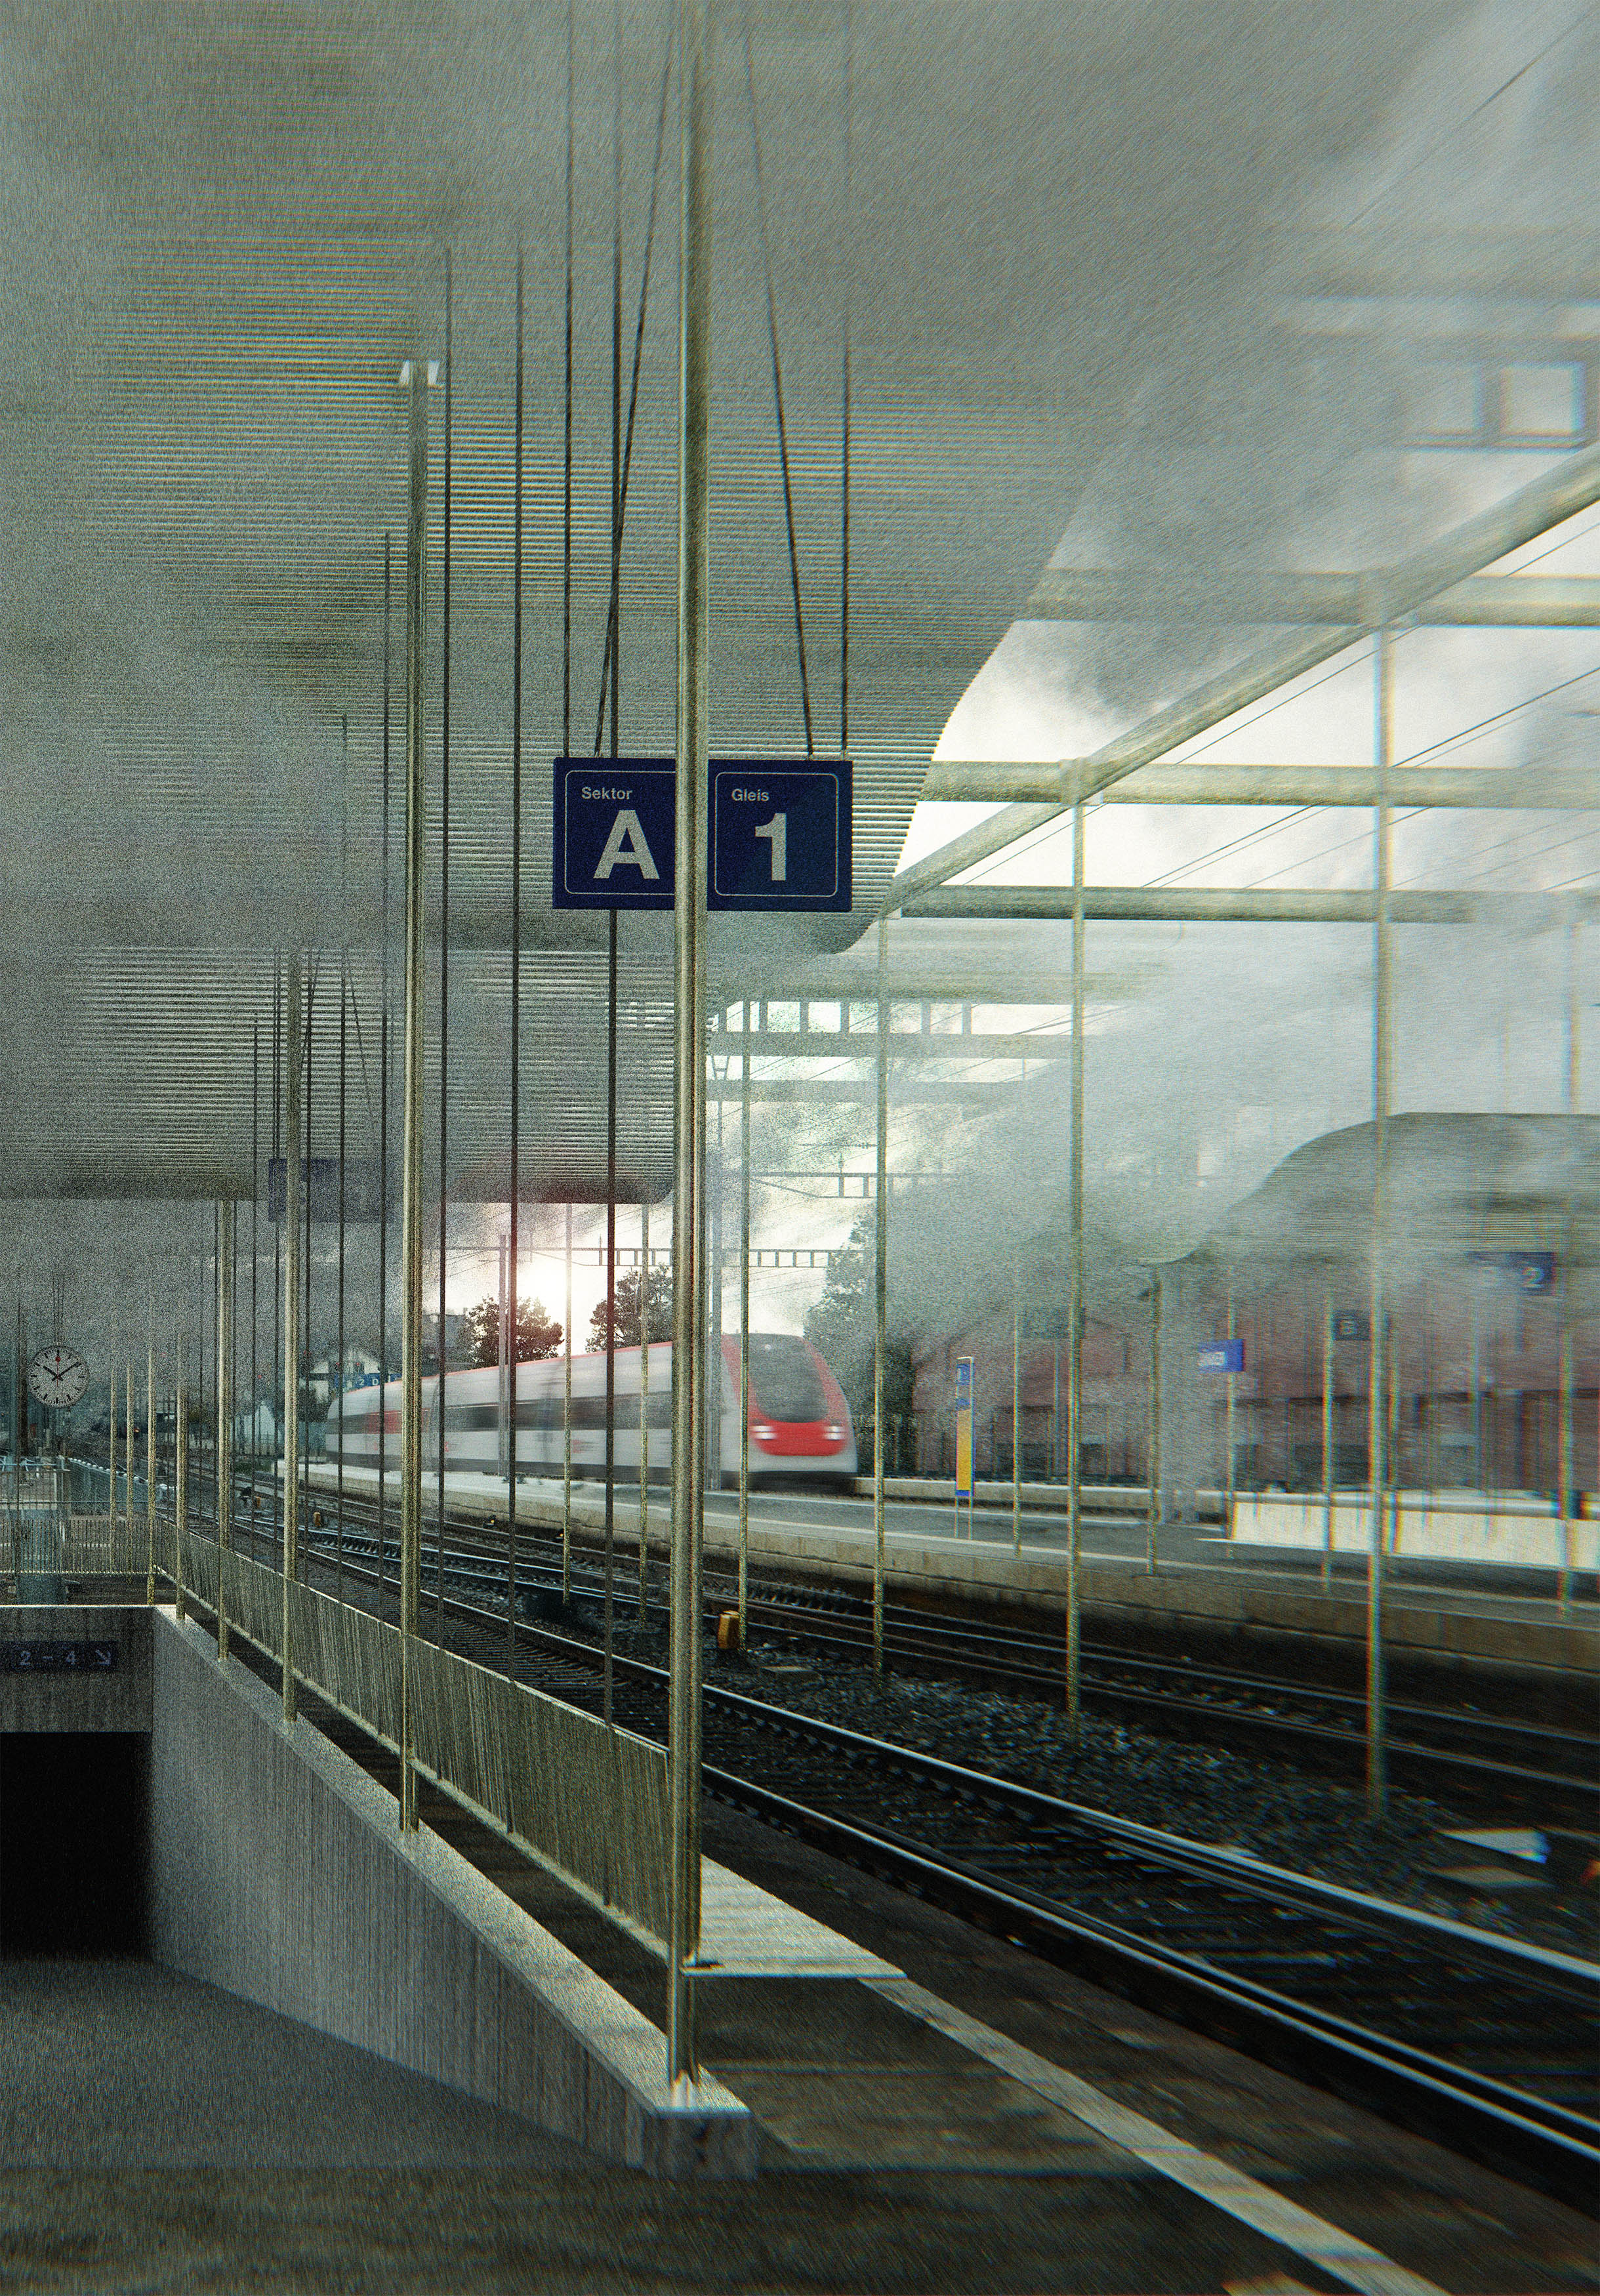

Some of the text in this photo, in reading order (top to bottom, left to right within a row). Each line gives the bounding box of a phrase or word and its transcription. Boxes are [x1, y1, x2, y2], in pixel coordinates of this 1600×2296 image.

[581, 787, 633, 800] Sektor
[731, 789, 770, 802] Gleis
[593, 810, 660, 880] A
[755, 813, 787, 881] 1
[1523, 1267, 1544, 1288] 2
[20, 1650, 31, 1666] 2
[65, 1650, 76, 1665] 4
